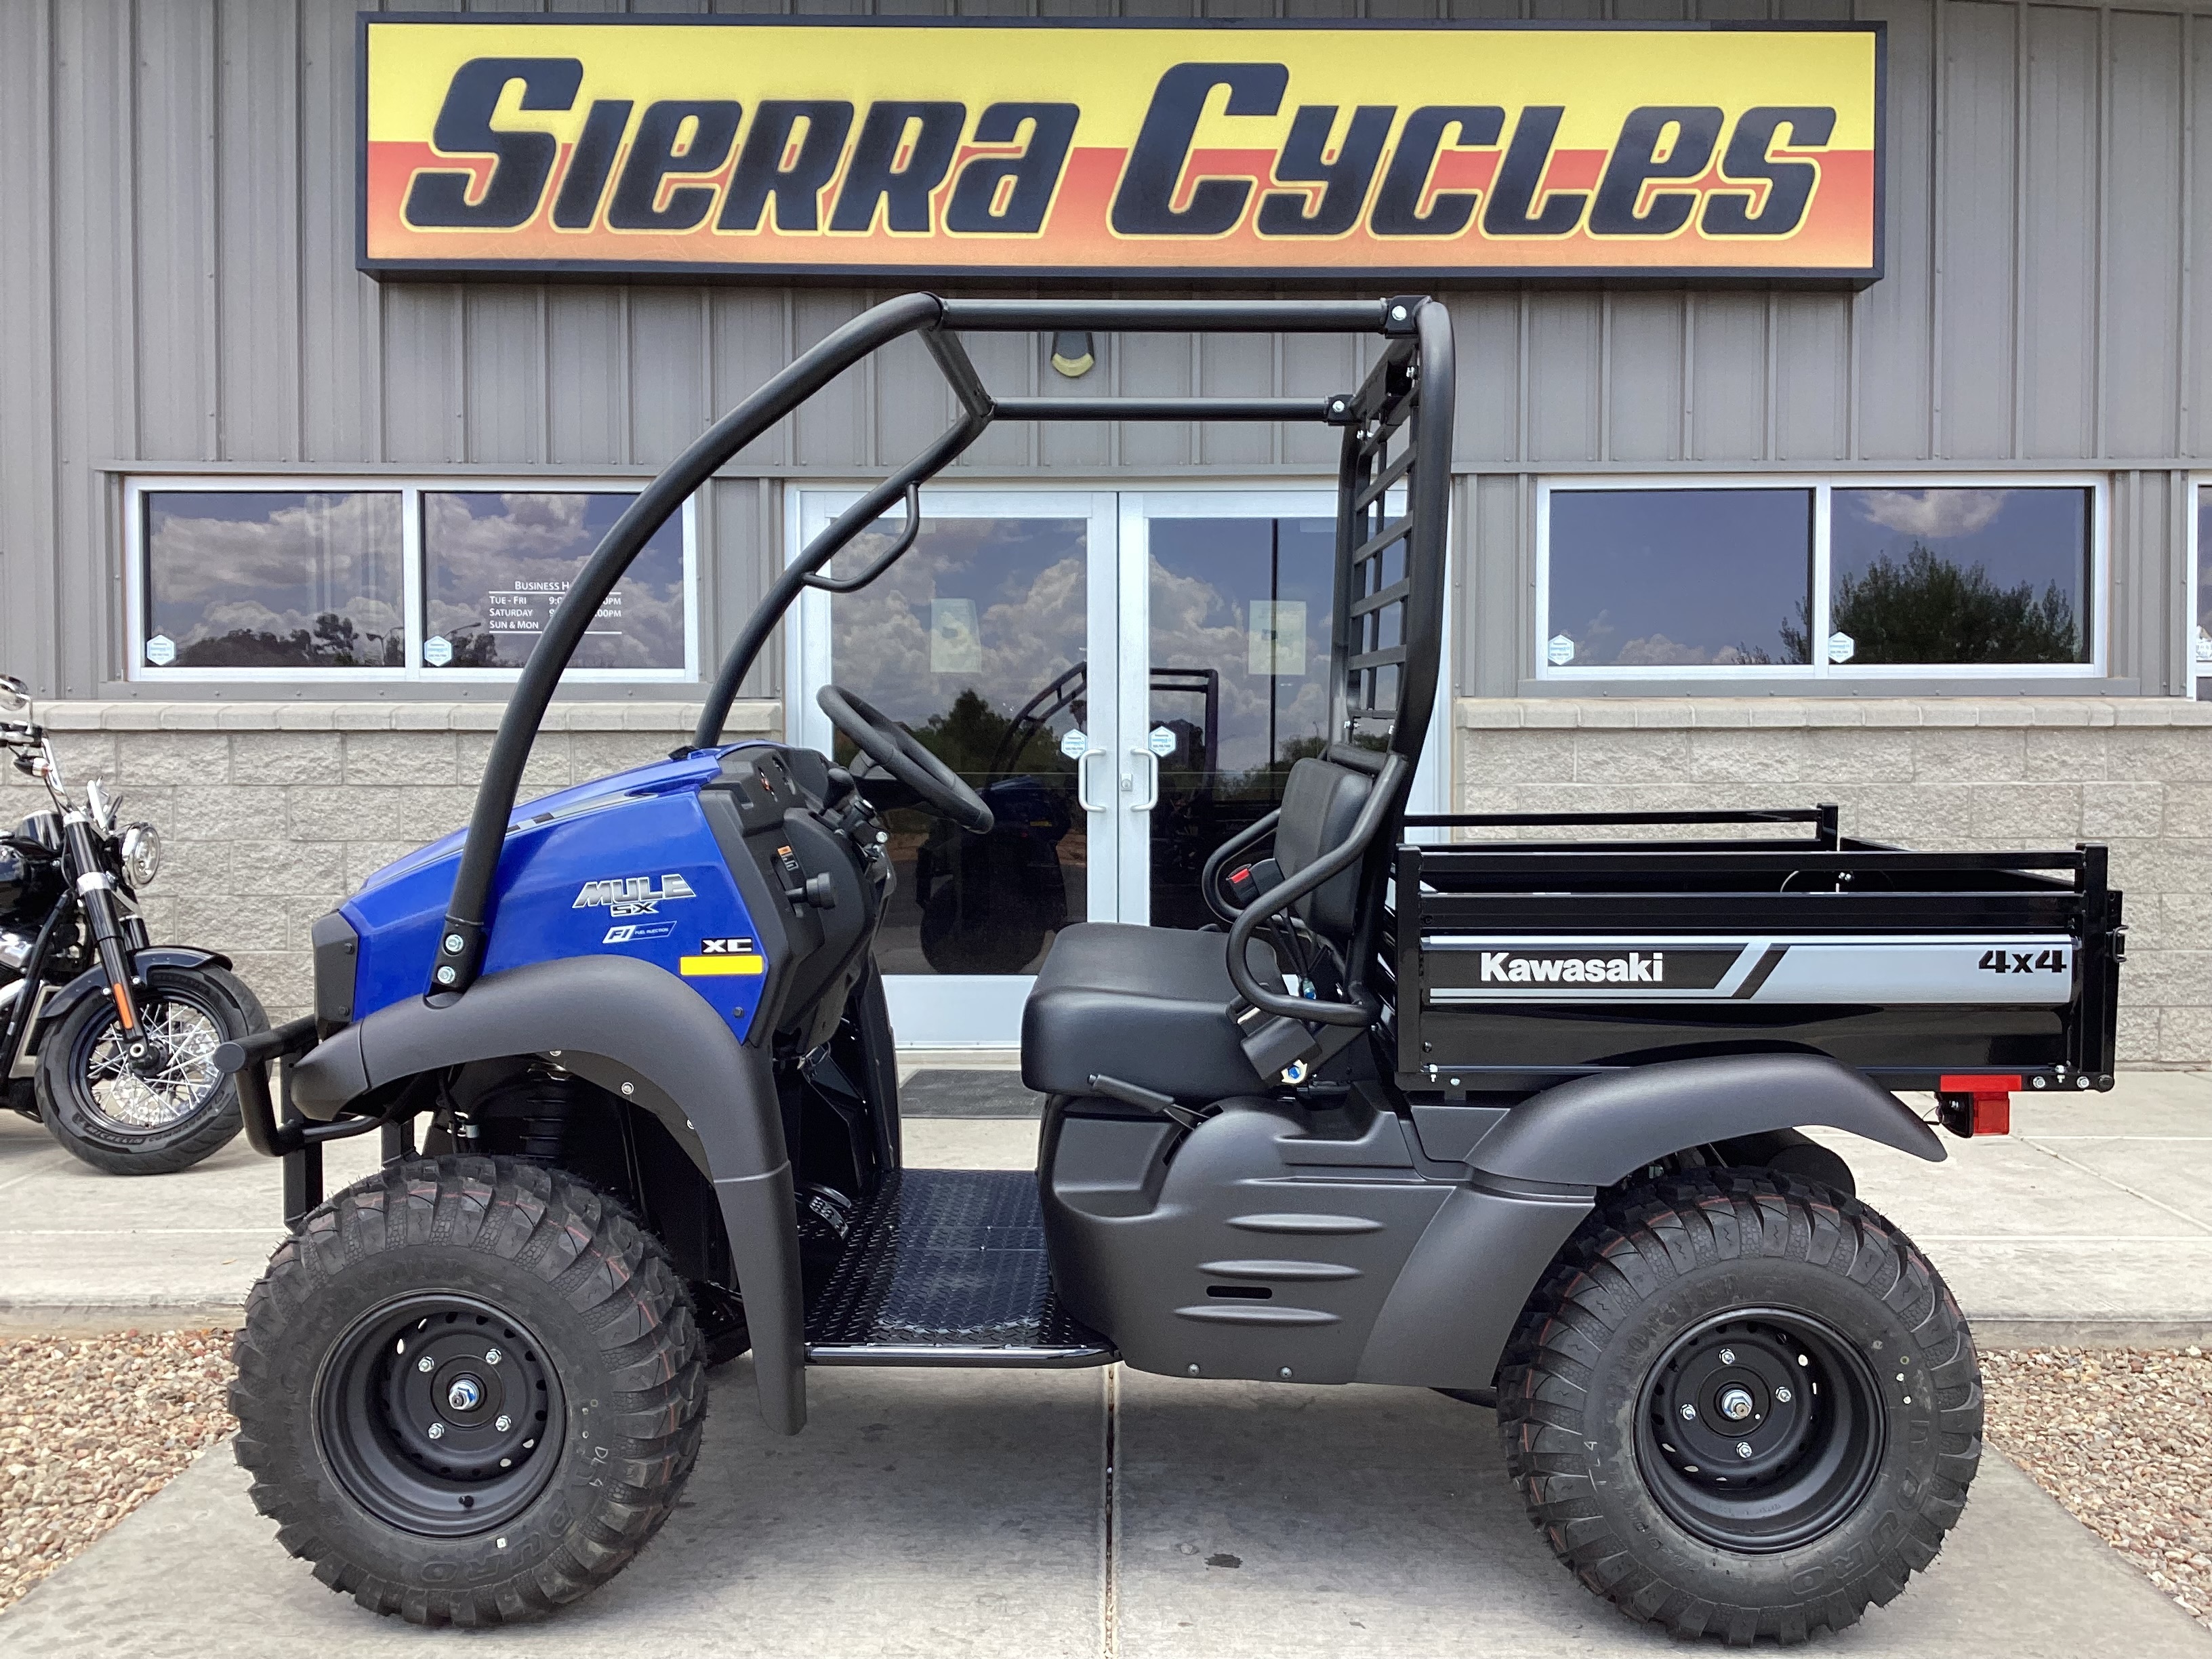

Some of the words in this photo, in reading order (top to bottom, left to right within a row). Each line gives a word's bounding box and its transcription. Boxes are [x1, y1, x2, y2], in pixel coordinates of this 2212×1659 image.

[489, 596, 506, 605] TUE
[513, 596, 527, 605] FRI
[489, 608, 533, 617] SATURDAY
[489, 620, 508, 629] SUN
[517, 621, 539, 629] MON
[572, 874, 696, 908] MULE
[611, 901, 659, 917] SX
[702, 939, 752, 954] XC
[1481, 952, 1664, 983] Kawasaki
[1978, 949, 2068, 974] 4x4
